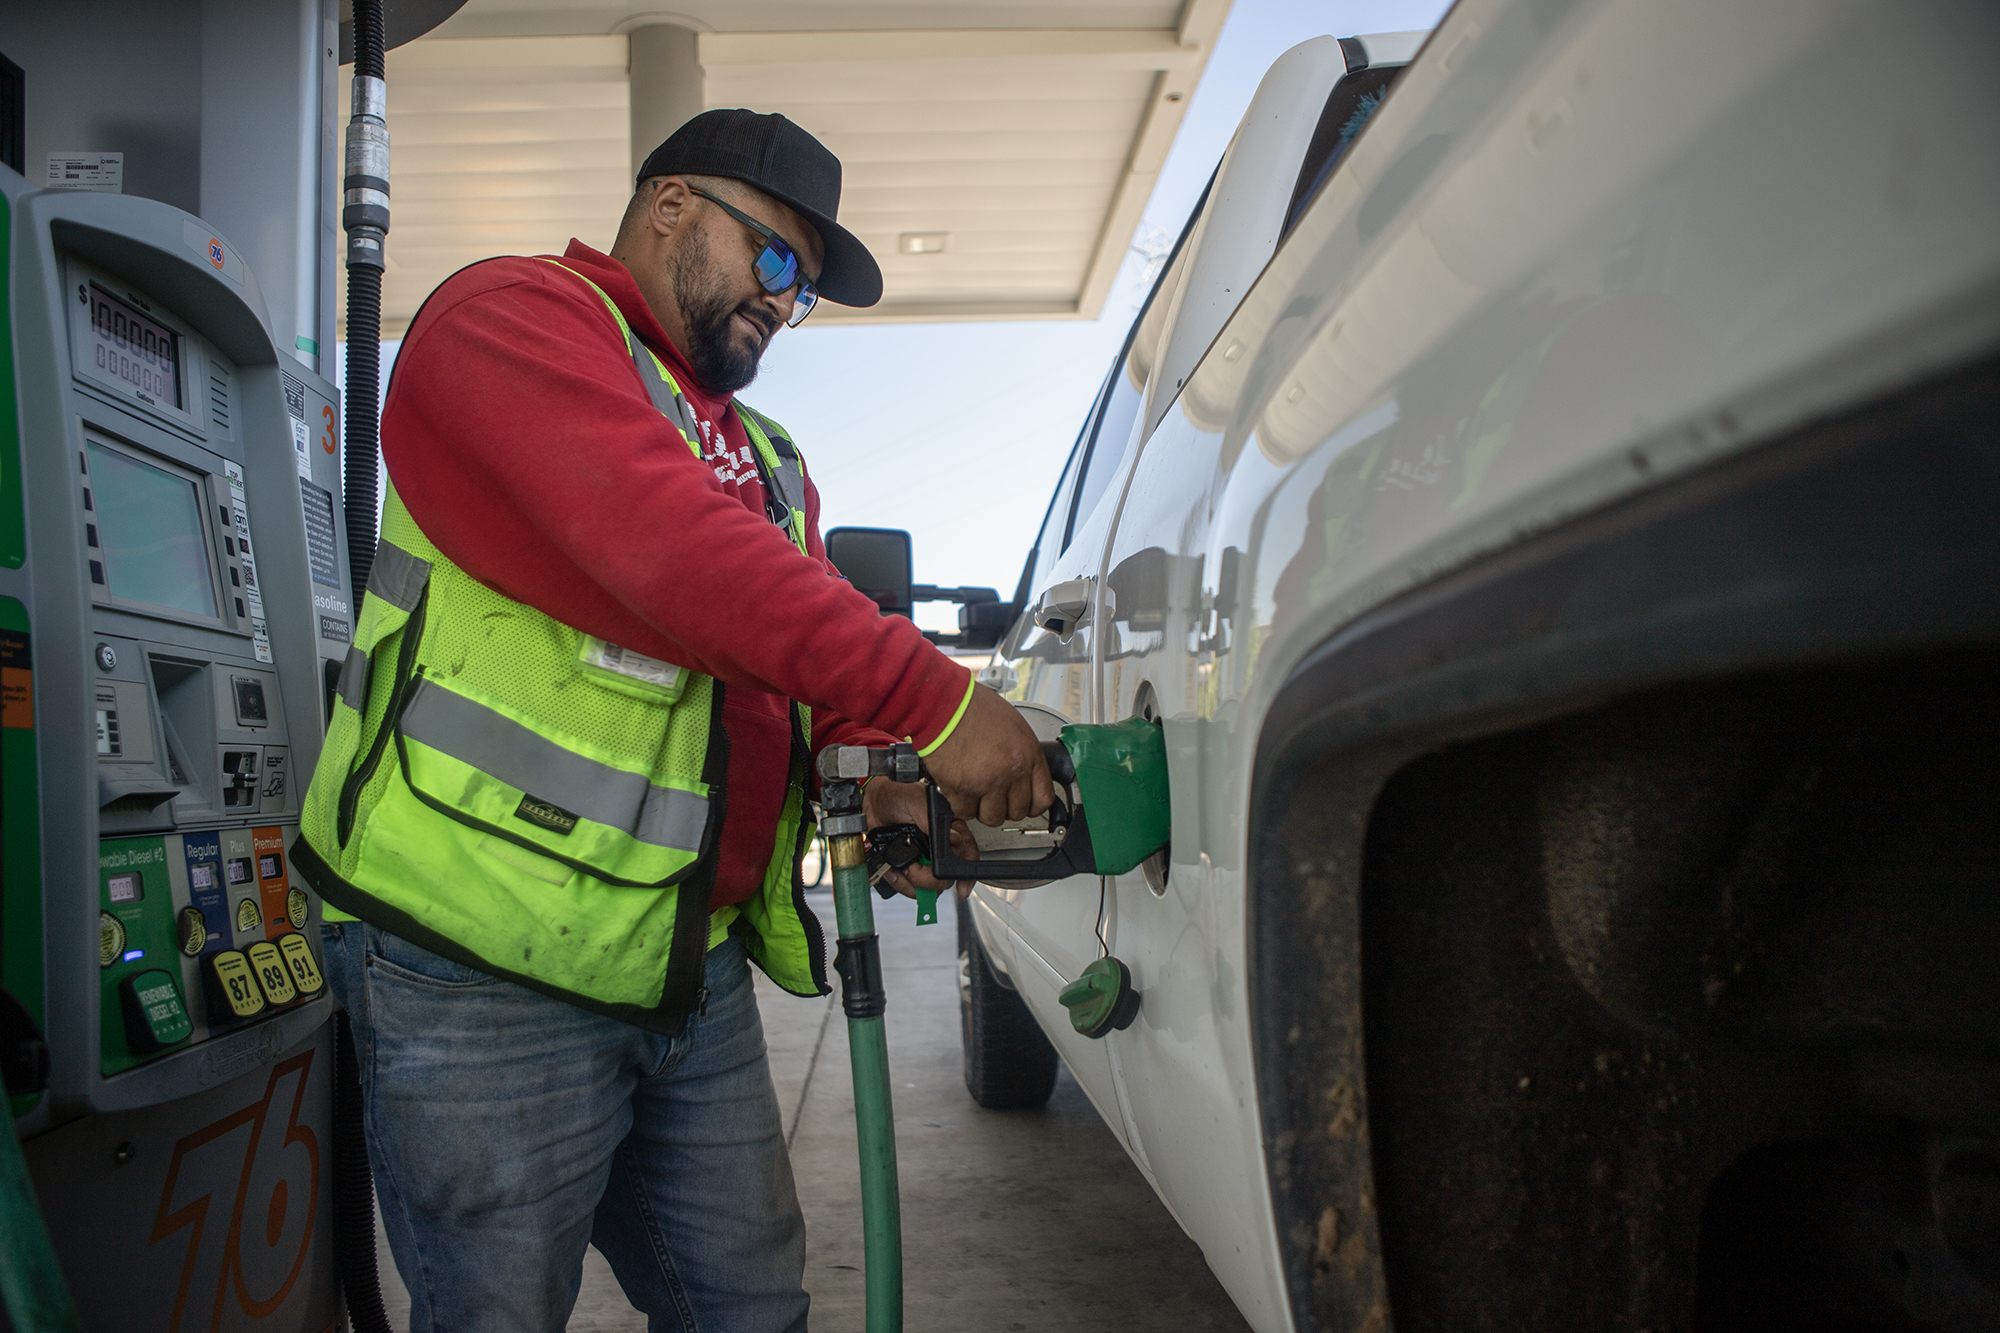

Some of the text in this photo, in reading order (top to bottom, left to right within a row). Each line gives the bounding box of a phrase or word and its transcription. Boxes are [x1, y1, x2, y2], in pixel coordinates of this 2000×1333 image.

[211, 244, 223, 263] 76
[79, 284, 88, 305] $
[321, 405, 336, 455] 3
[322, 619, 348, 634] CONTAINS
[187, 842, 219, 861] Regular
[229, 840, 246, 853] Plus
[254, 836, 283, 851] Premium
[128, 849, 153, 865] Diesel
[154, 847, 165, 861] #2
[262, 964, 286, 991] 89
[292, 955, 315, 981] 91
[138, 983, 176, 1006] RENEWABLE
[228, 974, 252, 1002] 87
[149, 1000, 181, 1021] DIESEL #2
[149, 1047, 320, 1333] 76
